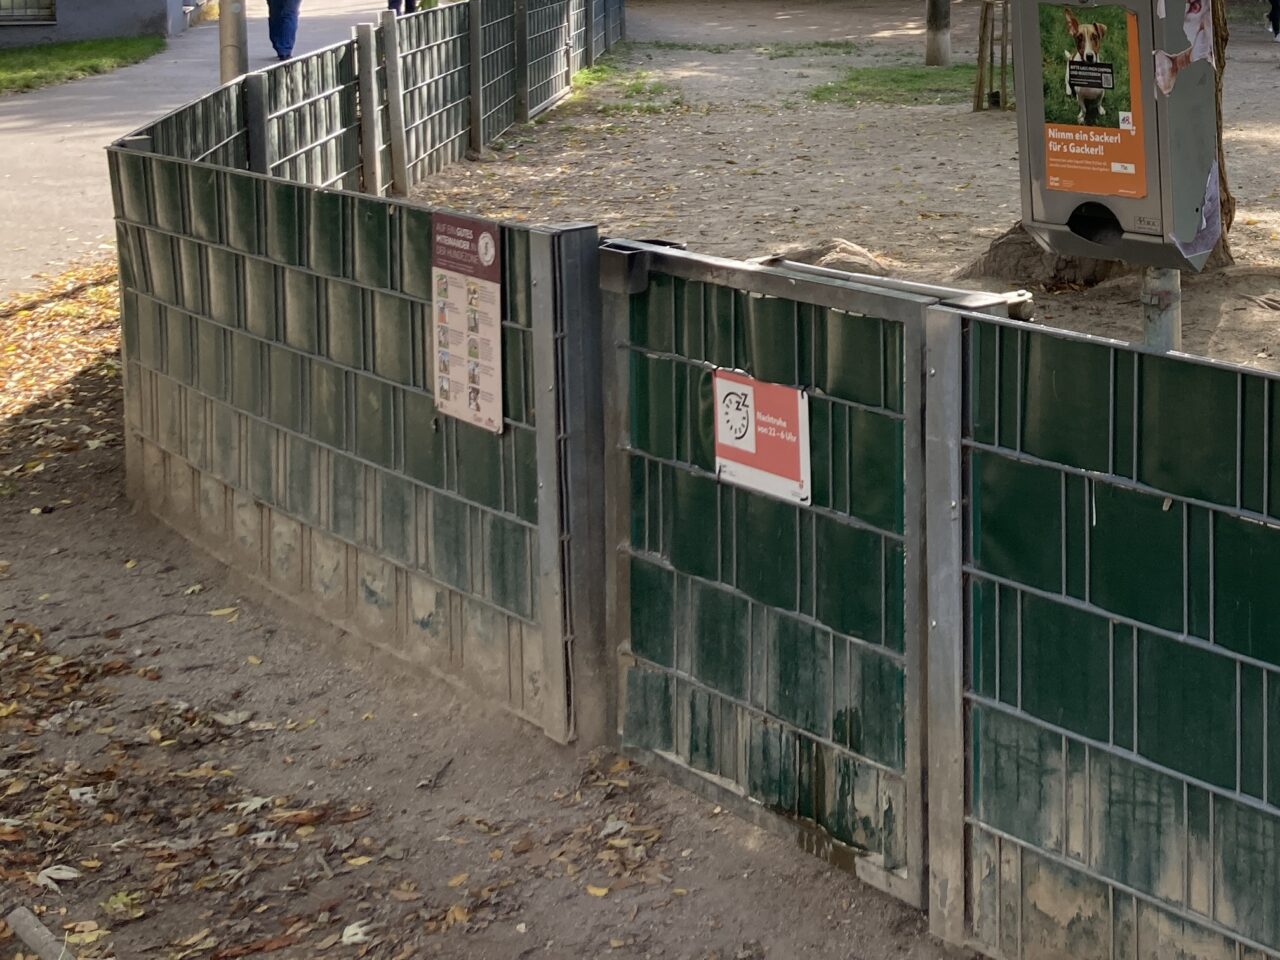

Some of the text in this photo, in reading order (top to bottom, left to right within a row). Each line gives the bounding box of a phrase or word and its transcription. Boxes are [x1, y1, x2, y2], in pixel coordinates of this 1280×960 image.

[1048, 128, 1121, 144] Nimm ein Sackerl
[1069, 142, 1105, 156] Gackerl!
[757, 425, 768, 433] von
[785, 431, 797, 443] Uhr
